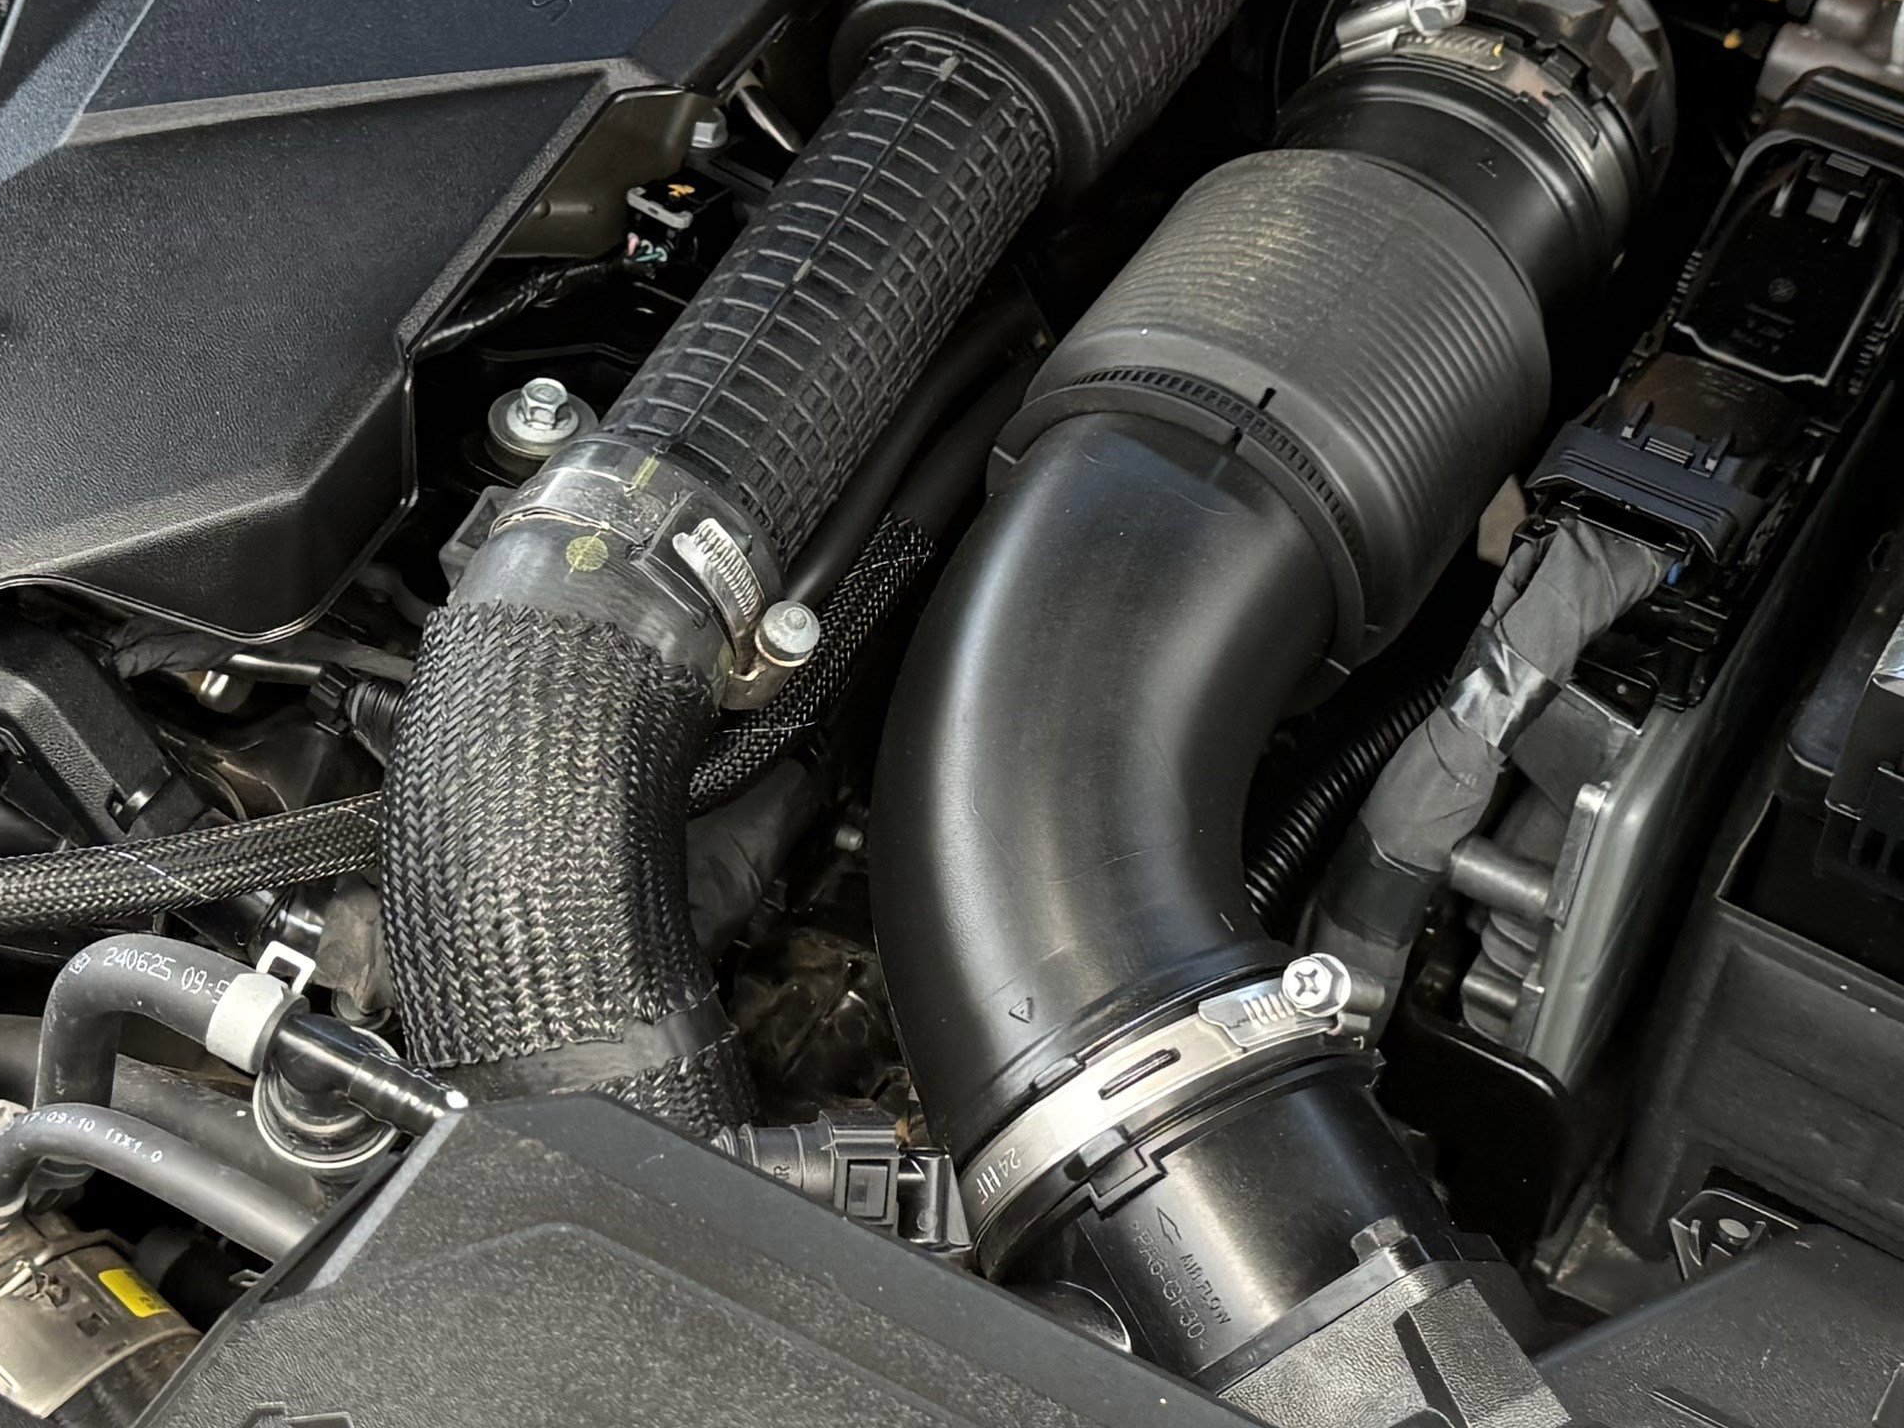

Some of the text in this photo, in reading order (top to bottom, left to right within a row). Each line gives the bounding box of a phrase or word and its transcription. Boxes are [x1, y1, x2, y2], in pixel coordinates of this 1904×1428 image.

[101, 948, 175, 985] 240625
[19, 1108, 96, 1134] 17:09:10
[994, 1146, 1026, 1178] 24
[1179, 1251, 1232, 1328] AIR FLOW
